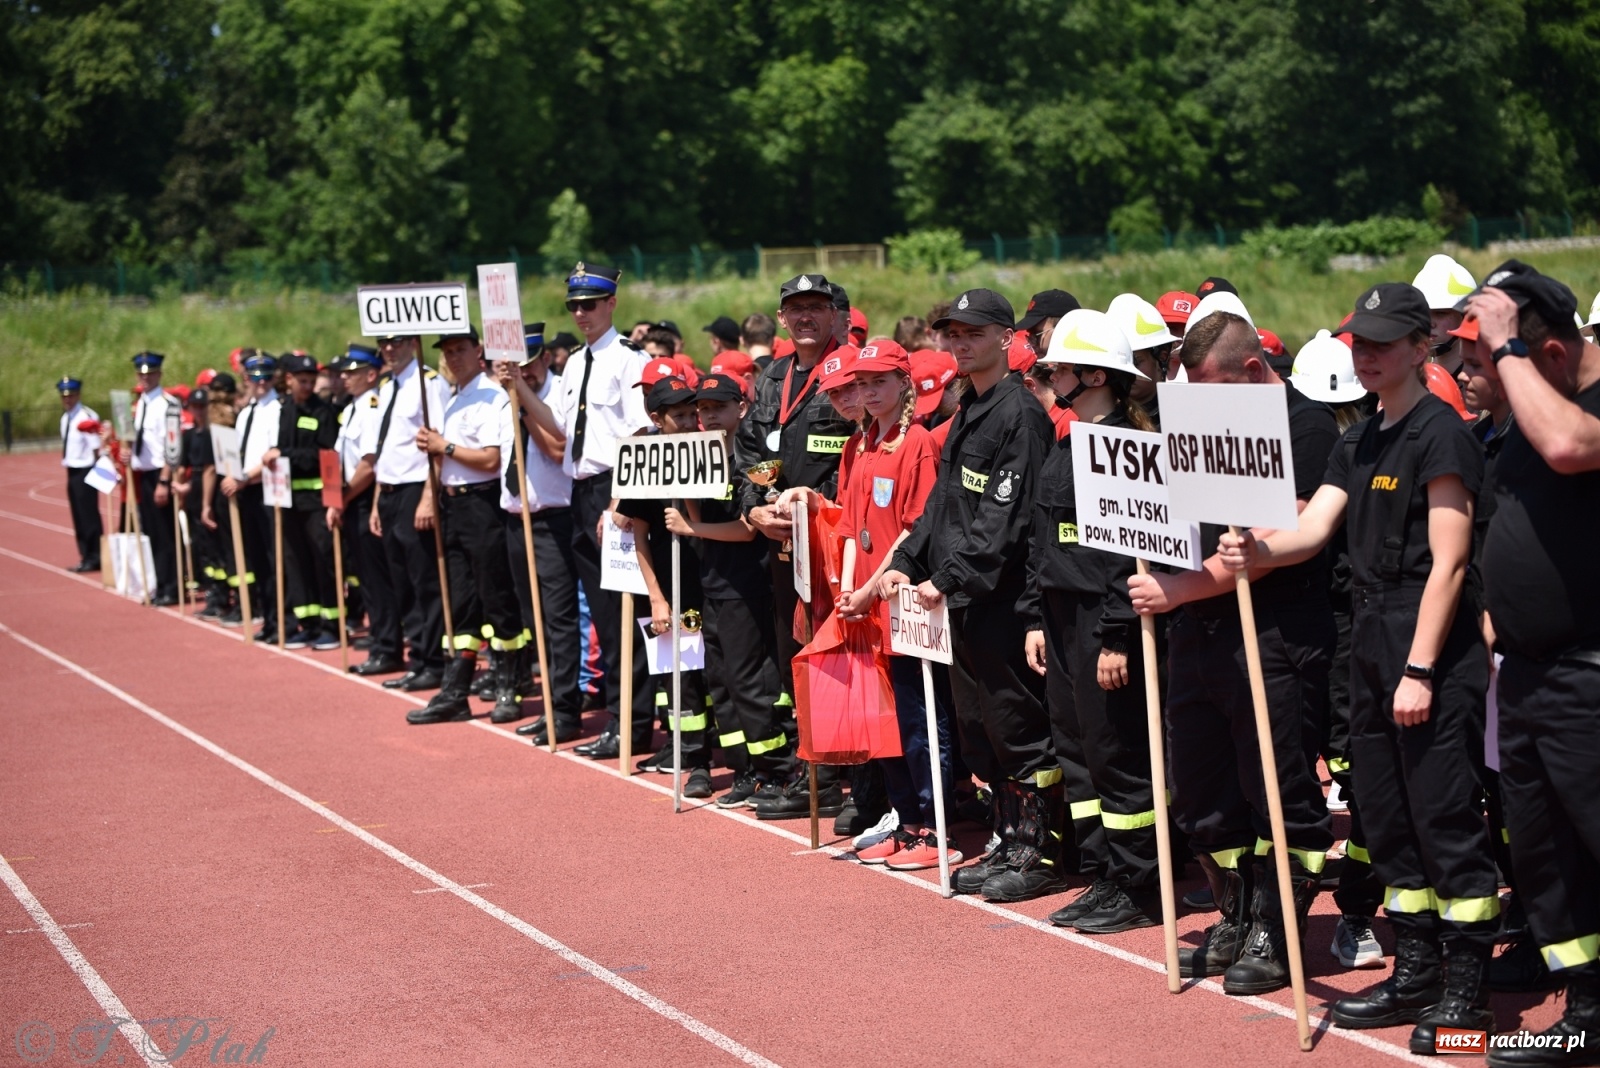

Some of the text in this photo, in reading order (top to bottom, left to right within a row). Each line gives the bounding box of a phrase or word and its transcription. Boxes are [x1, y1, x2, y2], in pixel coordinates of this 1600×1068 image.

[366, 295, 461, 324] GLIWICE
[617, 440, 725, 486] GRABOWA
[1089, 434, 1168, 486] LYSK
[1168, 429, 1284, 479] OSP HAŻLACH
[1099, 497, 1168, 525] gm. LYSKI
[610, 541, 635, 552] SZLACHEC
[1085, 524, 1189, 560] pow. RYBNICKI
[610, 559, 639, 571] DZIEWCZYN
[902, 588, 926, 615] OS
[891, 617, 949, 653] PANIÓWKI
